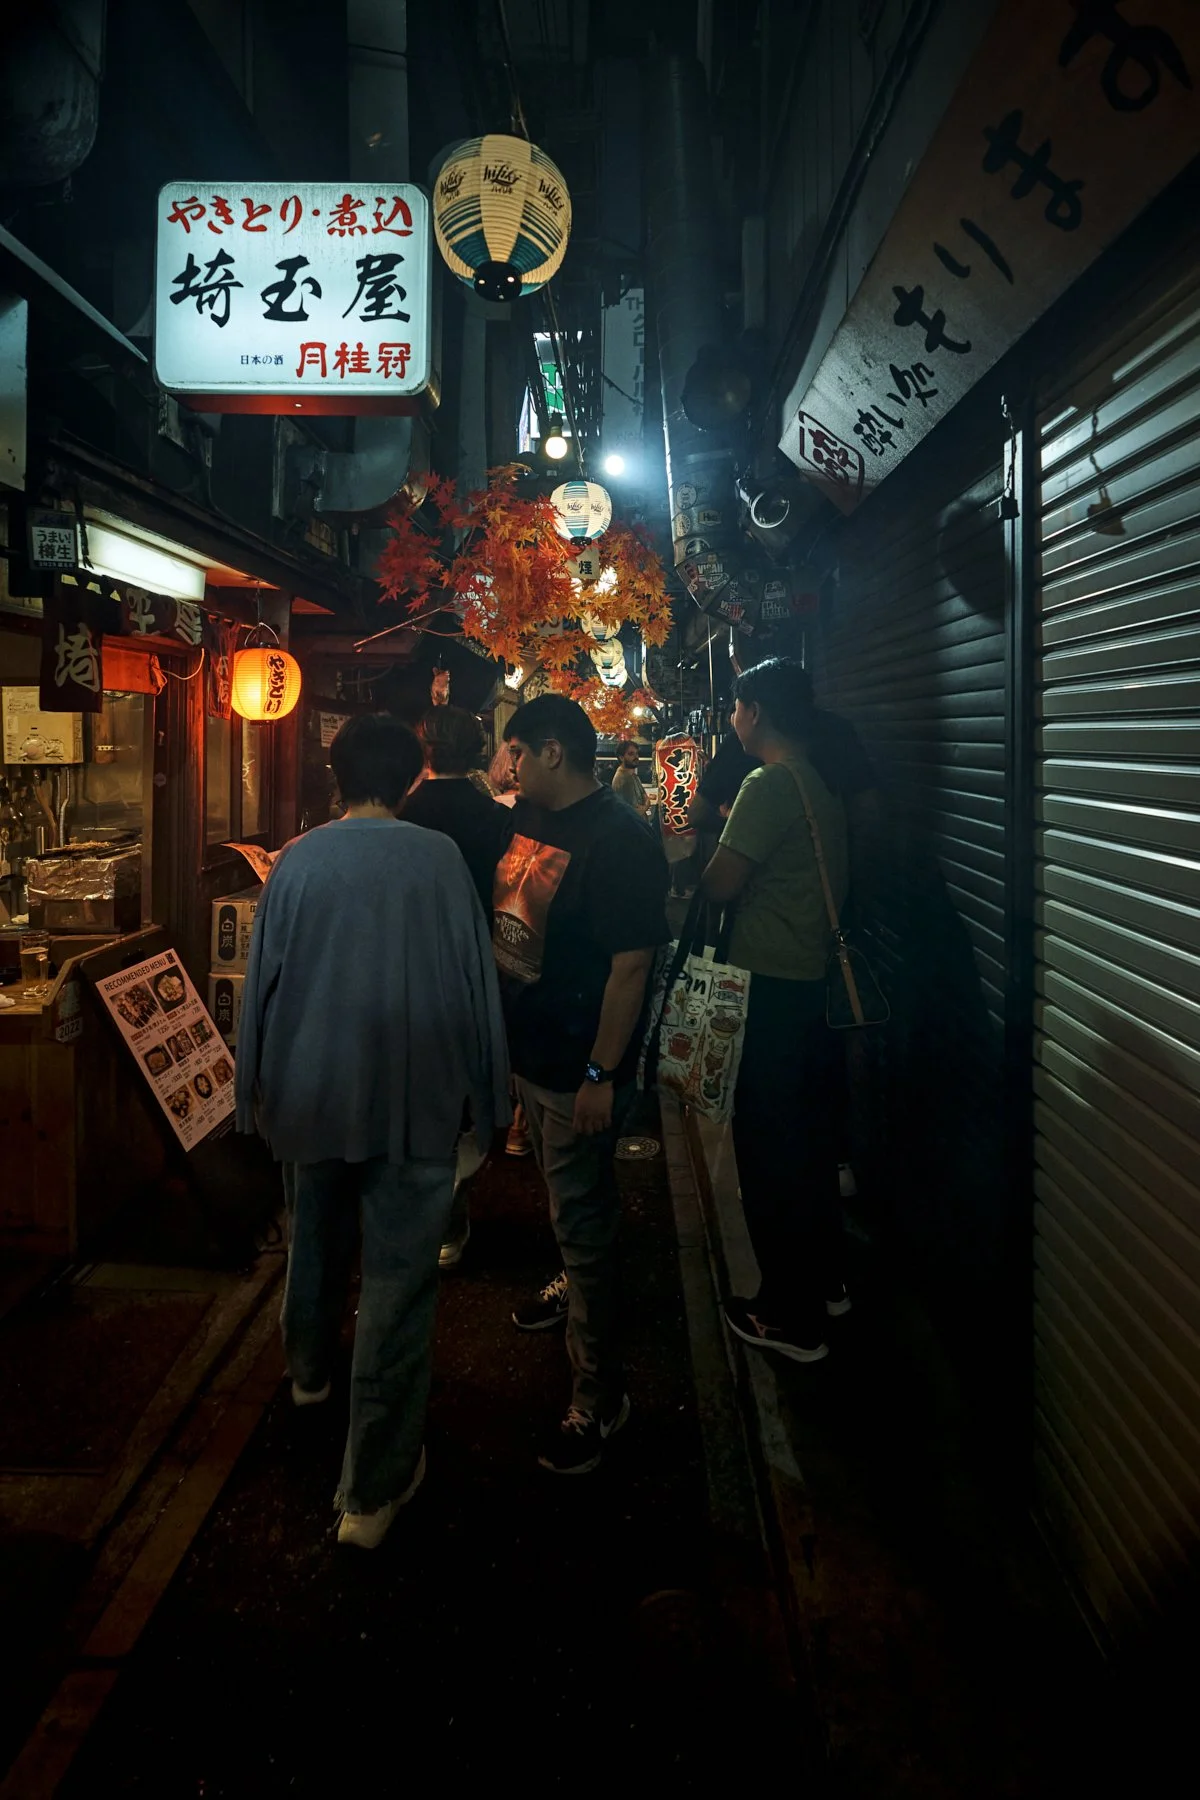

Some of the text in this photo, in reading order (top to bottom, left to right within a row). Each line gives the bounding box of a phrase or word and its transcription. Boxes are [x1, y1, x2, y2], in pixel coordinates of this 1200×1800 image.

[167, 193, 414, 238] やきとり・煮込
[169, 247, 411, 328] 埼玉屋
[239, 342, 411, 379] 日本の酒 月桂冠
[37, 529, 71, 544] うまい!
[38, 543, 73, 560] 樽生
[265, 654, 286, 713] やきとり
[220, 918, 235, 949] 白炭
[103, 965, 151, 992] RECOMMENDED
[149, 957, 168, 971] MENU
[217, 991, 232, 1022] 白炭
[59, 1019, 80, 1039] 2022
